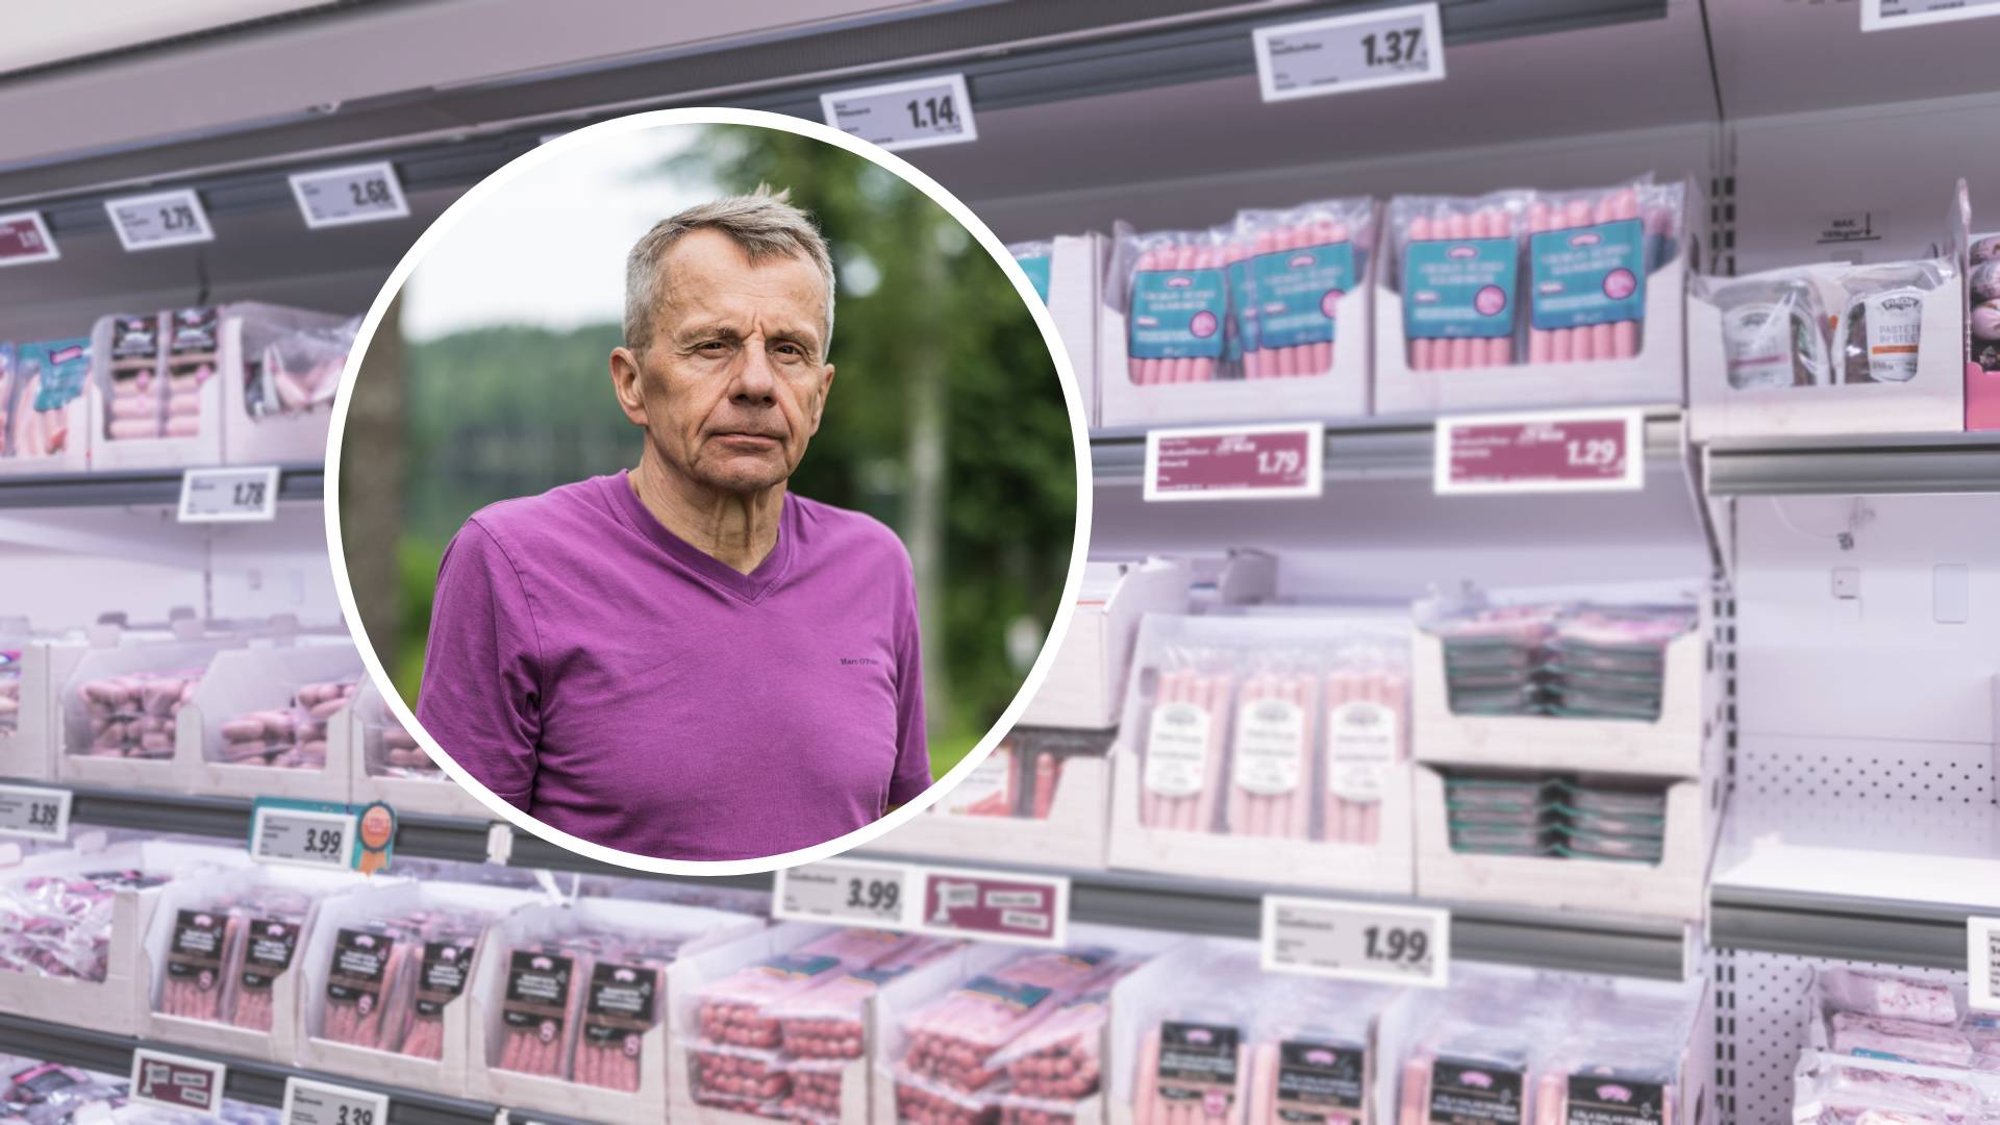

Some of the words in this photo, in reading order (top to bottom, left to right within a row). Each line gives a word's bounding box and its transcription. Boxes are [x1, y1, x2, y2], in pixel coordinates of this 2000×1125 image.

[1361, 28, 1422, 66] 1.37
[907, 95, 954, 129] 1.14
[350, 179, 391, 206] 2.68
[160, 206, 194, 230] 2.79
[1257, 450, 1299, 475] 1.79
[1566, 439, 1616, 466] 1.29
[233, 482, 266, 505] 1.78
[29, 803, 58, 826] 3.39
[304, 828, 342, 854] 3.99
[847, 877, 900, 911] 3.99
[1364, 925, 1429, 963] 1.99
